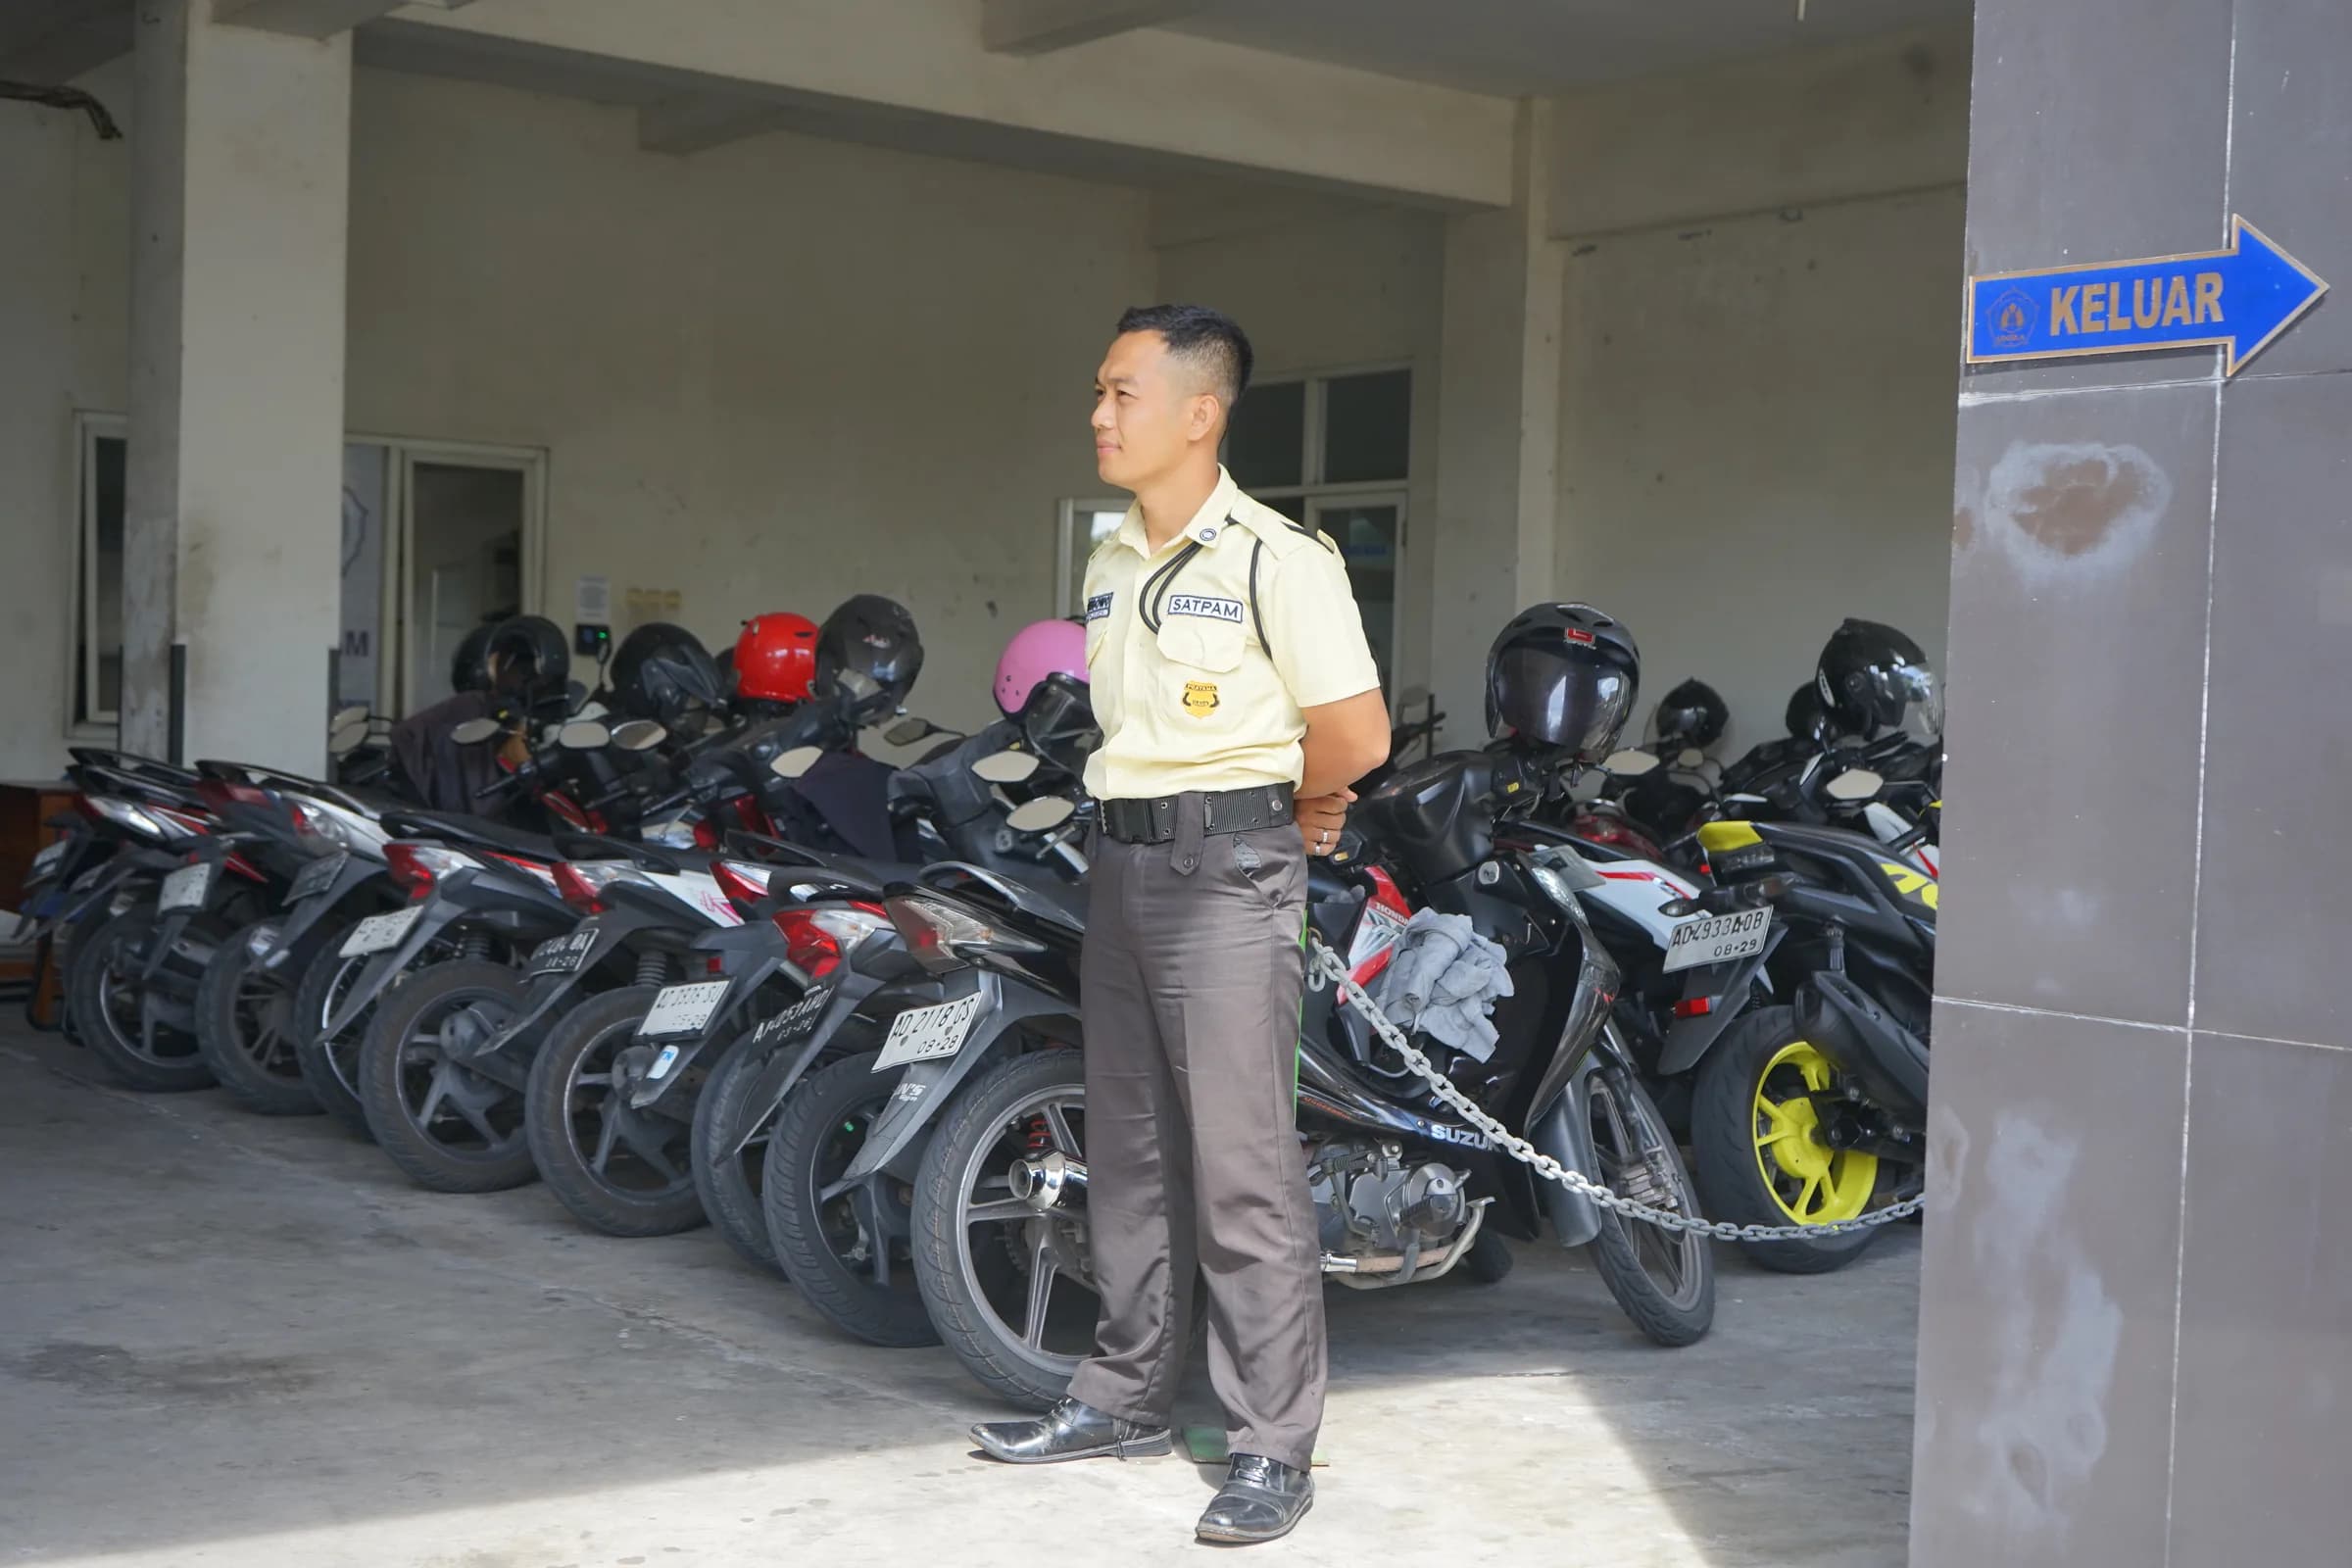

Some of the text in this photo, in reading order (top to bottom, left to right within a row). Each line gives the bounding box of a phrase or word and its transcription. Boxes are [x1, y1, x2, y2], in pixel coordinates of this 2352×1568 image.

[2050, 272, 2225, 336] KELUAR
[1172, 598, 1239, 619] SATPAM
[890, 1012, 913, 1041] AD
[911, 1004, 955, 1034] 2118
